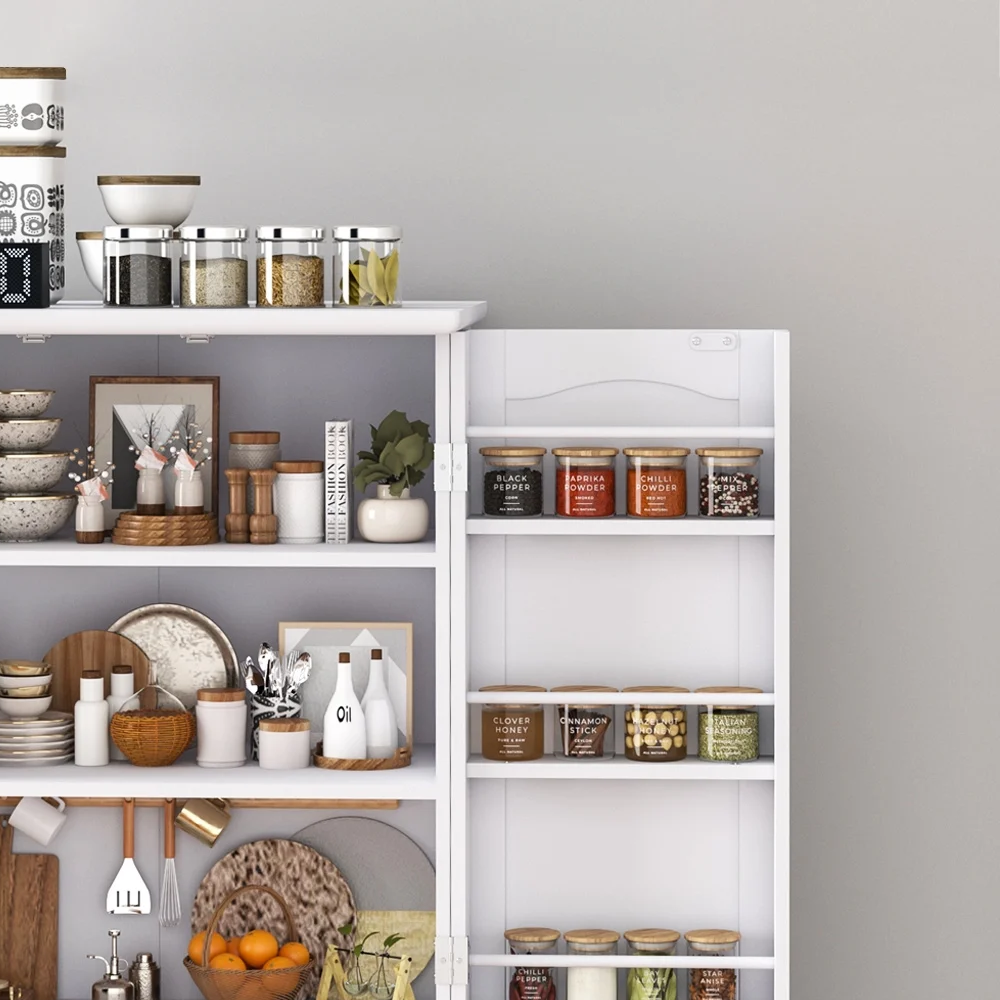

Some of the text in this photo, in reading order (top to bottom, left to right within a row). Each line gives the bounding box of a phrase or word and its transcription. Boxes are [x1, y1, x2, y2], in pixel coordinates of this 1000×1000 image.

[327, 426, 336, 460] BOOK
[338, 426, 346, 460] BOOK
[327, 463, 336, 515] FASHION
[338, 463, 346, 515] FASHION
[636, 484, 677, 492] POWDER
[640, 475, 672, 483] CHILLI
[336, 705, 352, 723] Oil
[570, 726, 597, 734] STICK
